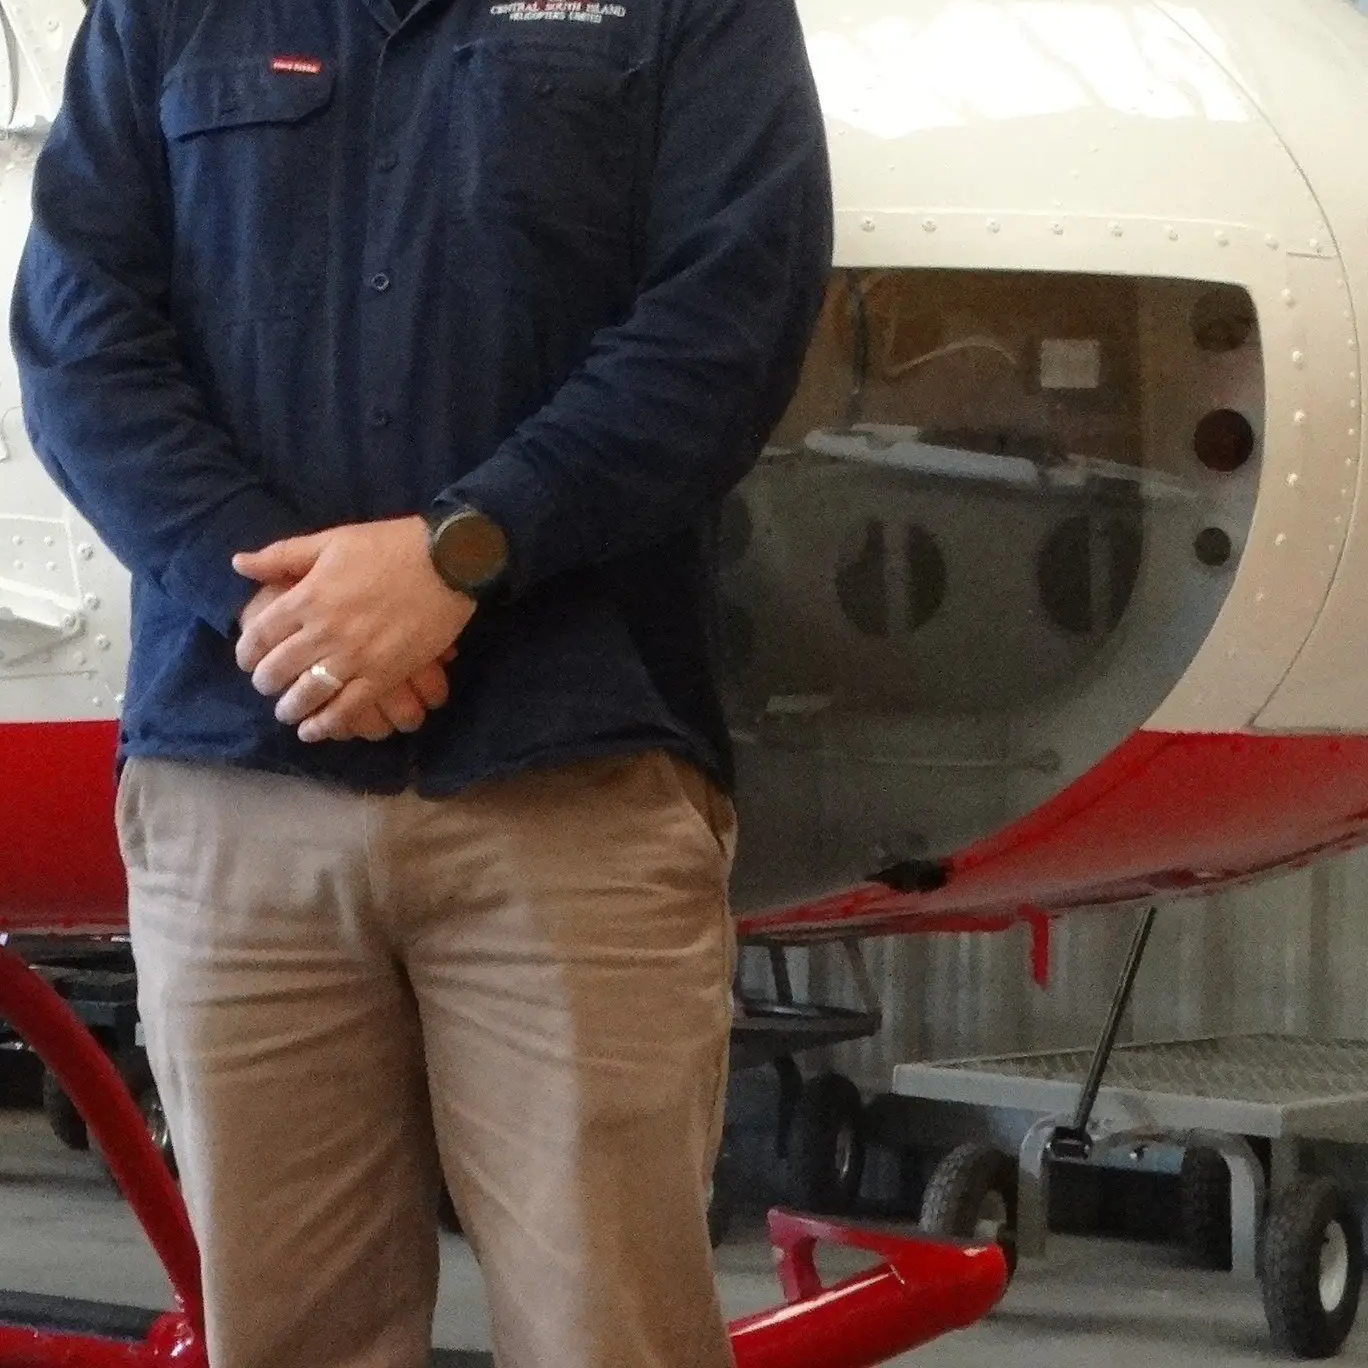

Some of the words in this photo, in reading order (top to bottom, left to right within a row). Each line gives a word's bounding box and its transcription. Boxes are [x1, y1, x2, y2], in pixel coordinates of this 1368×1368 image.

[490, 1, 538, 15] CENTRAL
[545, 1, 582, 12] SOUTH
[586, 2, 626, 17] ISLAND
